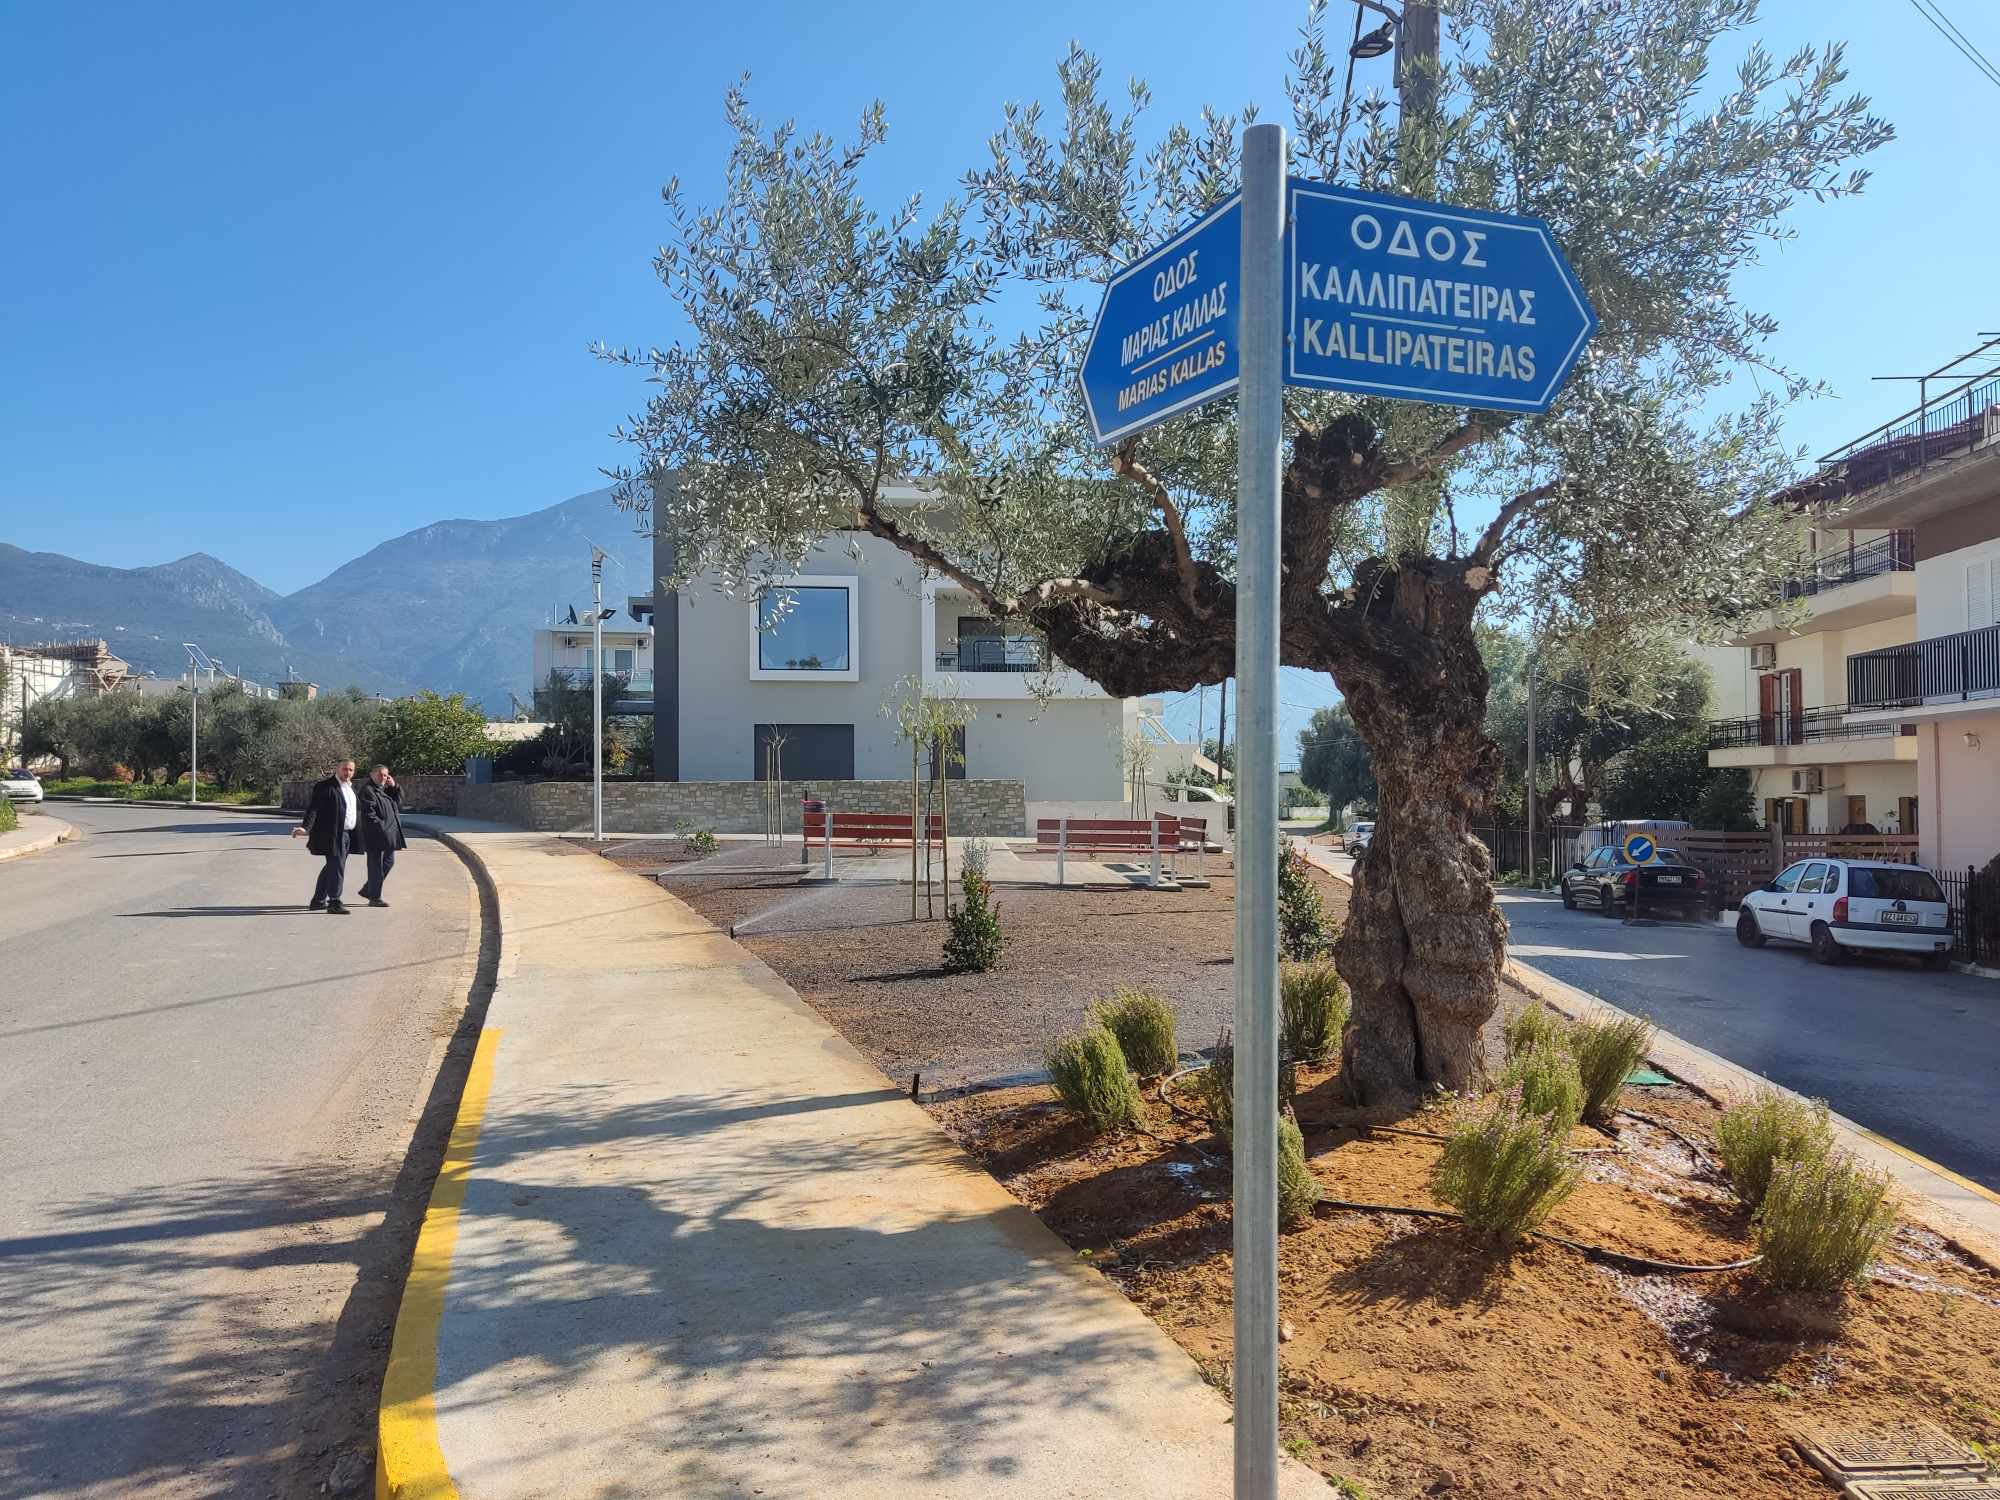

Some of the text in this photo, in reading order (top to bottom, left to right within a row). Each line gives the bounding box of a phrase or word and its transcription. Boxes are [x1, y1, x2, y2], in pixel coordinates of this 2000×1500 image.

[1351, 215, 1486, 267] ΟΔΟΣ
[1154, 250, 1197, 302] ΟΔΟΣ
[1302, 262, 1535, 324] ΚΑΛΛΙΠΑΤΕΙΡΑΣ
[1122, 282, 1226, 366] ΜΑΡΙΑΣ ΚΑΛΛΑΣ
[1304, 318, 1535, 381] KALLIPATEIRAS
[1119, 341, 1225, 411] MARIAS KALLAS
